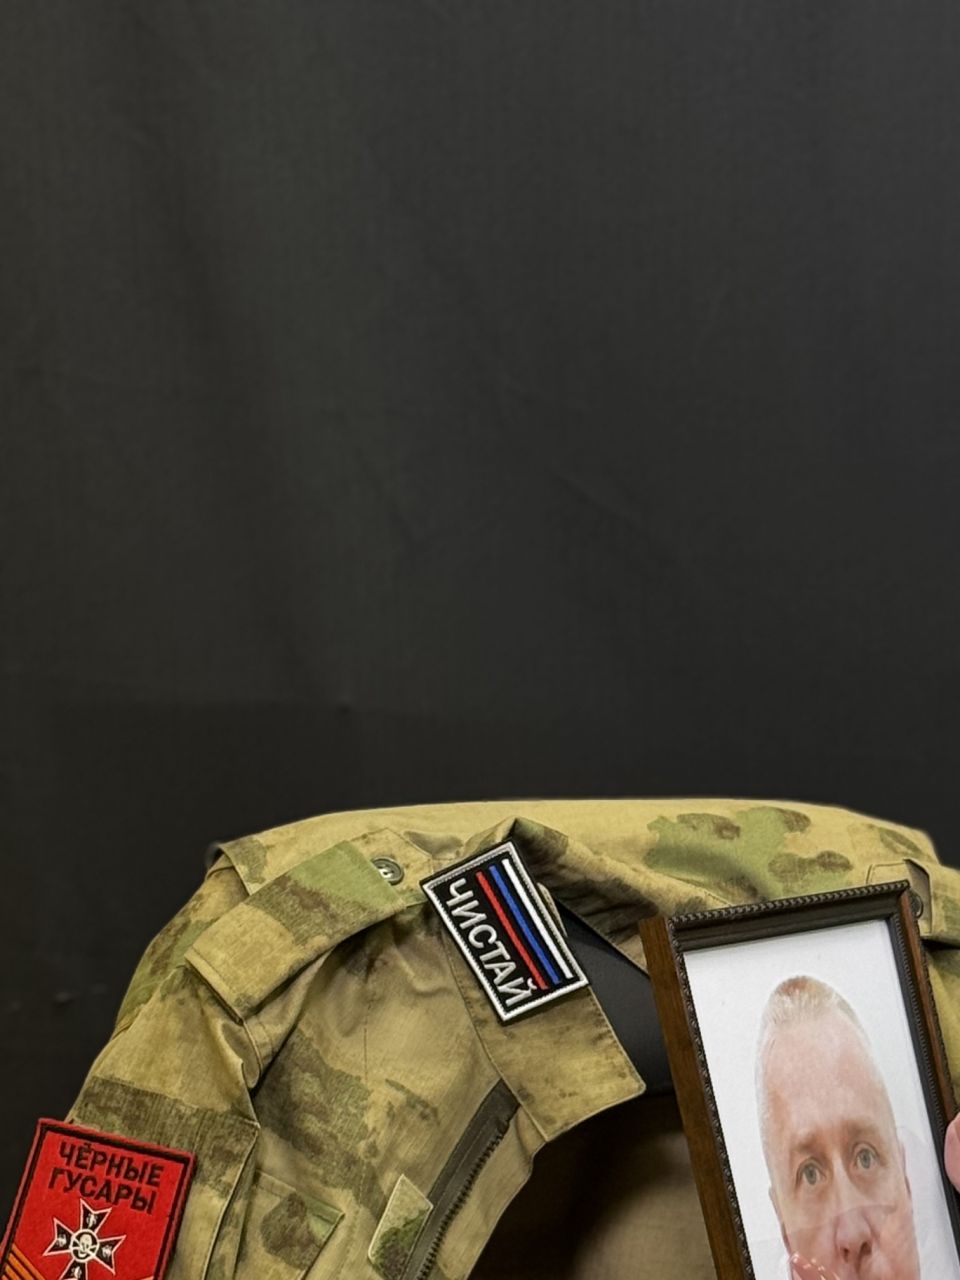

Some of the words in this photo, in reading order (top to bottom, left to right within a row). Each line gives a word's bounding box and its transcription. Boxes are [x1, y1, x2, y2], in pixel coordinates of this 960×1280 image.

[446, 878, 537, 1006] ЧИСТАЙ
[59, 1142, 164, 1187] ЧЁРНЫЕ
[48, 1167, 157, 1215] ГУСАРЫ
